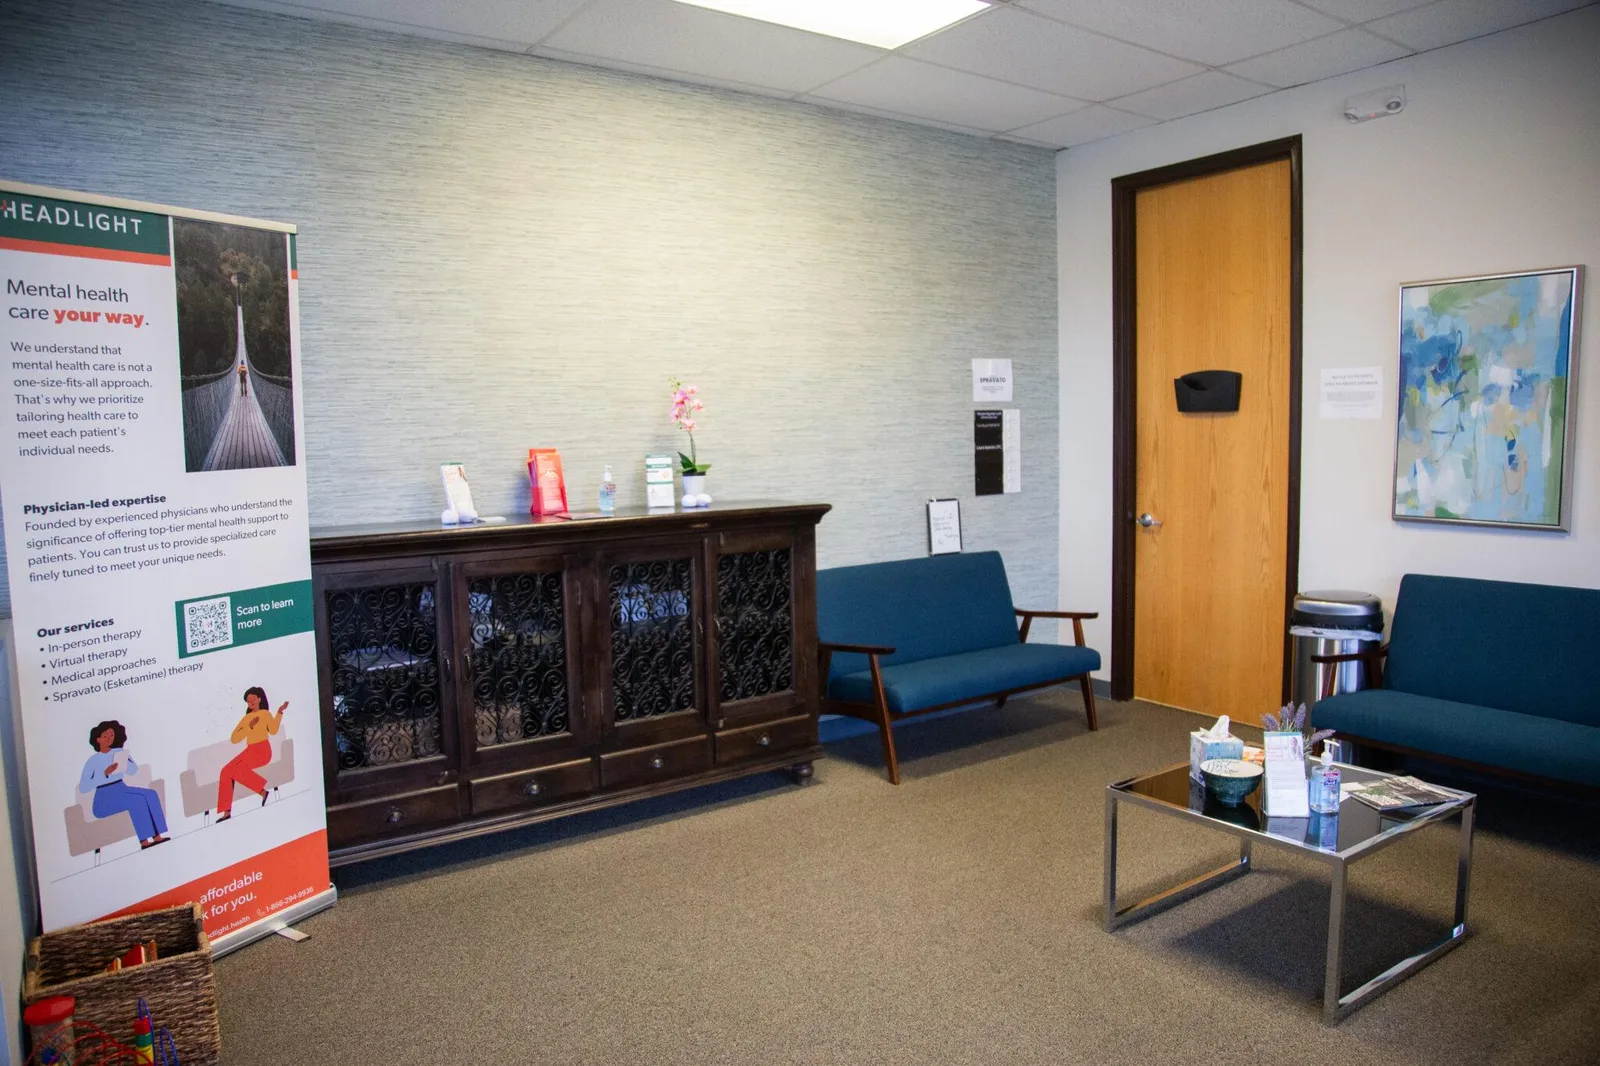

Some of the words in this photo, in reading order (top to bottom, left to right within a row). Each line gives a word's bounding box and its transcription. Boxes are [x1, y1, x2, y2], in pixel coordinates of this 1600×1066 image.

[3, 200, 142, 235] HEADLIGHT
[7, 278, 71, 299] Mental
[76, 285, 129, 303] health
[8, 307, 49, 320] care
[53, 309, 101, 324] your
[104, 312, 149, 329] way.
[10, 341, 32, 353] We
[34, 343, 99, 355] understand
[101, 345, 122, 355] that
[12, 360, 53, 371] mental
[55, 361, 90, 372] health
[92, 363, 116, 372] care
[117, 362, 126, 372] is
[128, 362, 144, 372] not
[13, 377, 98, 388] one-size-fits-all
[100, 378, 153, 389] approach.
[15, 394, 51, 405] That's
[53, 395, 77, 406] why
[79, 396, 96, 405] we
[98, 395, 144, 406] prioritize
[16, 412, 65, 423] tailoring
[67, 411, 101, 421] health
[103, 412, 126, 421] care
[128, 412, 139, 420] to
[18, 429, 48, 439] meet
[50, 428, 77, 438] each
[80, 427, 126, 440] patient's
[19, 445, 75, 457] individual
[78, 444, 114, 454] needs.
[23, 499, 109, 515] Physician-led
[112, 494, 166, 508] expertise
[25, 518, 76, 532] Founded
[79, 517, 93, 528] by
[95, 510, 159, 526] experienced
[161, 507, 209, 520] physicians
[210, 504, 230, 514] who
[231, 498, 278, 512] understand
[279, 497, 293, 507] the
[26, 535, 92, 550] significance
[95, 531, 106, 541] of
[108, 529, 147, 539] offering
[149, 524, 185, 536] top-tier
[187, 519, 217, 531] mental
[218, 516, 246, 527] health
[247, 514, 279, 525] support
[280, 512, 289, 521] to
[28, 552, 77, 568] patients.
[79, 549, 101, 559] You
[103, 547, 122, 557] can
[123, 543, 146, 554] trust
[148, 541, 159, 551] us
[161, 539, 171, 550] to
[173, 535, 209, 549] provide
[210, 530, 258, 543] specialized
[259, 528, 277, 537] care
[29, 570, 60, 583] finely
[62, 565, 95, 578] tuned
[96, 564, 108, 574] to
[110, 559, 136, 572] meet
[138, 558, 161, 570] your
[162, 553, 195, 564] unique
[196, 548, 226, 560] needs.
[236, 605, 260, 617] Scan
[260, 603, 271, 612] to
[271, 599, 294, 609] learn
[37, 626, 62, 638] Our
[64, 618, 114, 634] services
[237, 618, 263, 630] more
[48, 636, 101, 653] In-person
[102, 629, 142, 643] therapy
[49, 653, 86, 669] Virtual
[87, 648, 128, 663] therapy
[51, 669, 96, 686] Medical
[97, 656, 157, 678] approaches
[53, 683, 102, 702] Spravato
[104, 667, 167, 692] (Esketamine)
[168, 661, 204, 676] therapy
[200, 870, 263, 904] affordable
[211, 902, 230, 917] for
[231, 892, 257, 911] you.
[207, 915, 251, 939] dlight.health
